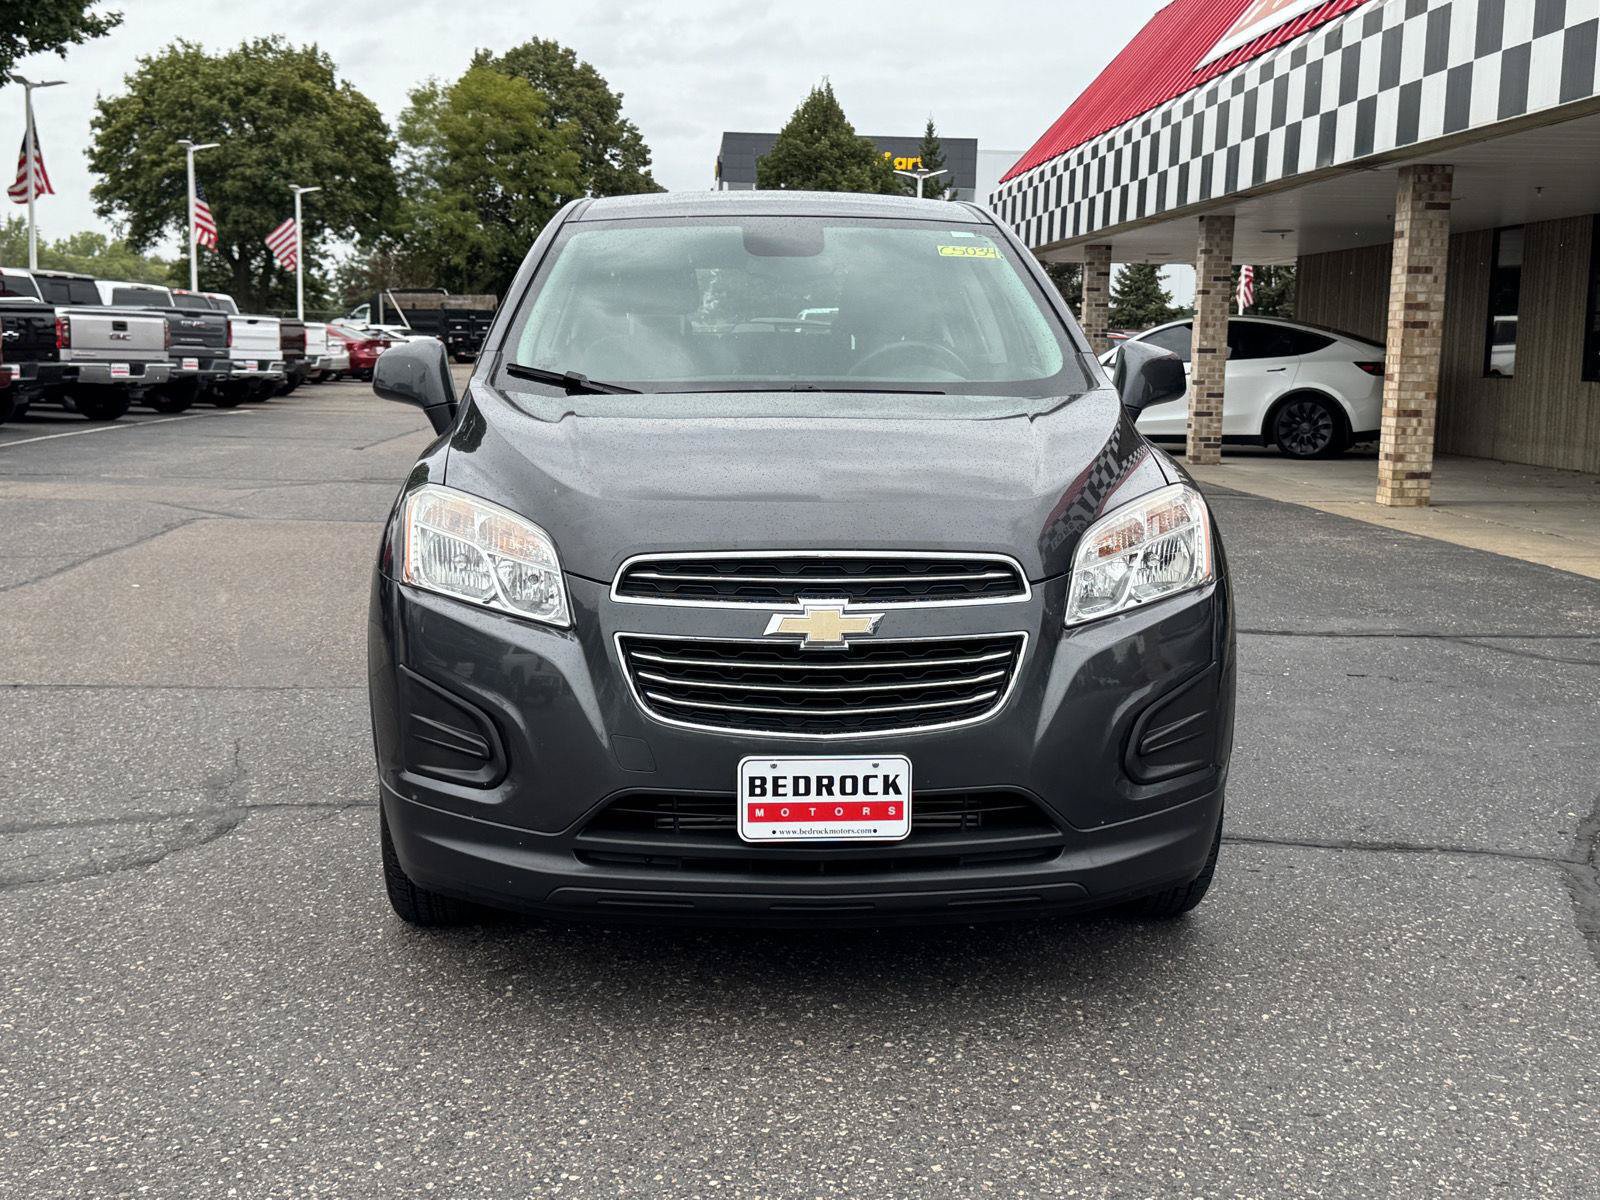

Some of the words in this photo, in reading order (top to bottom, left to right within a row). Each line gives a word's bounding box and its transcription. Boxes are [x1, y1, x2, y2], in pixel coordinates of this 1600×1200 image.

[109, 332, 131, 341] GMC
[748, 774, 902, 797] BEDROCK
[755, 806, 896, 818] MOTORS
[778, 827, 872, 836] www.bedrockmotors.com
